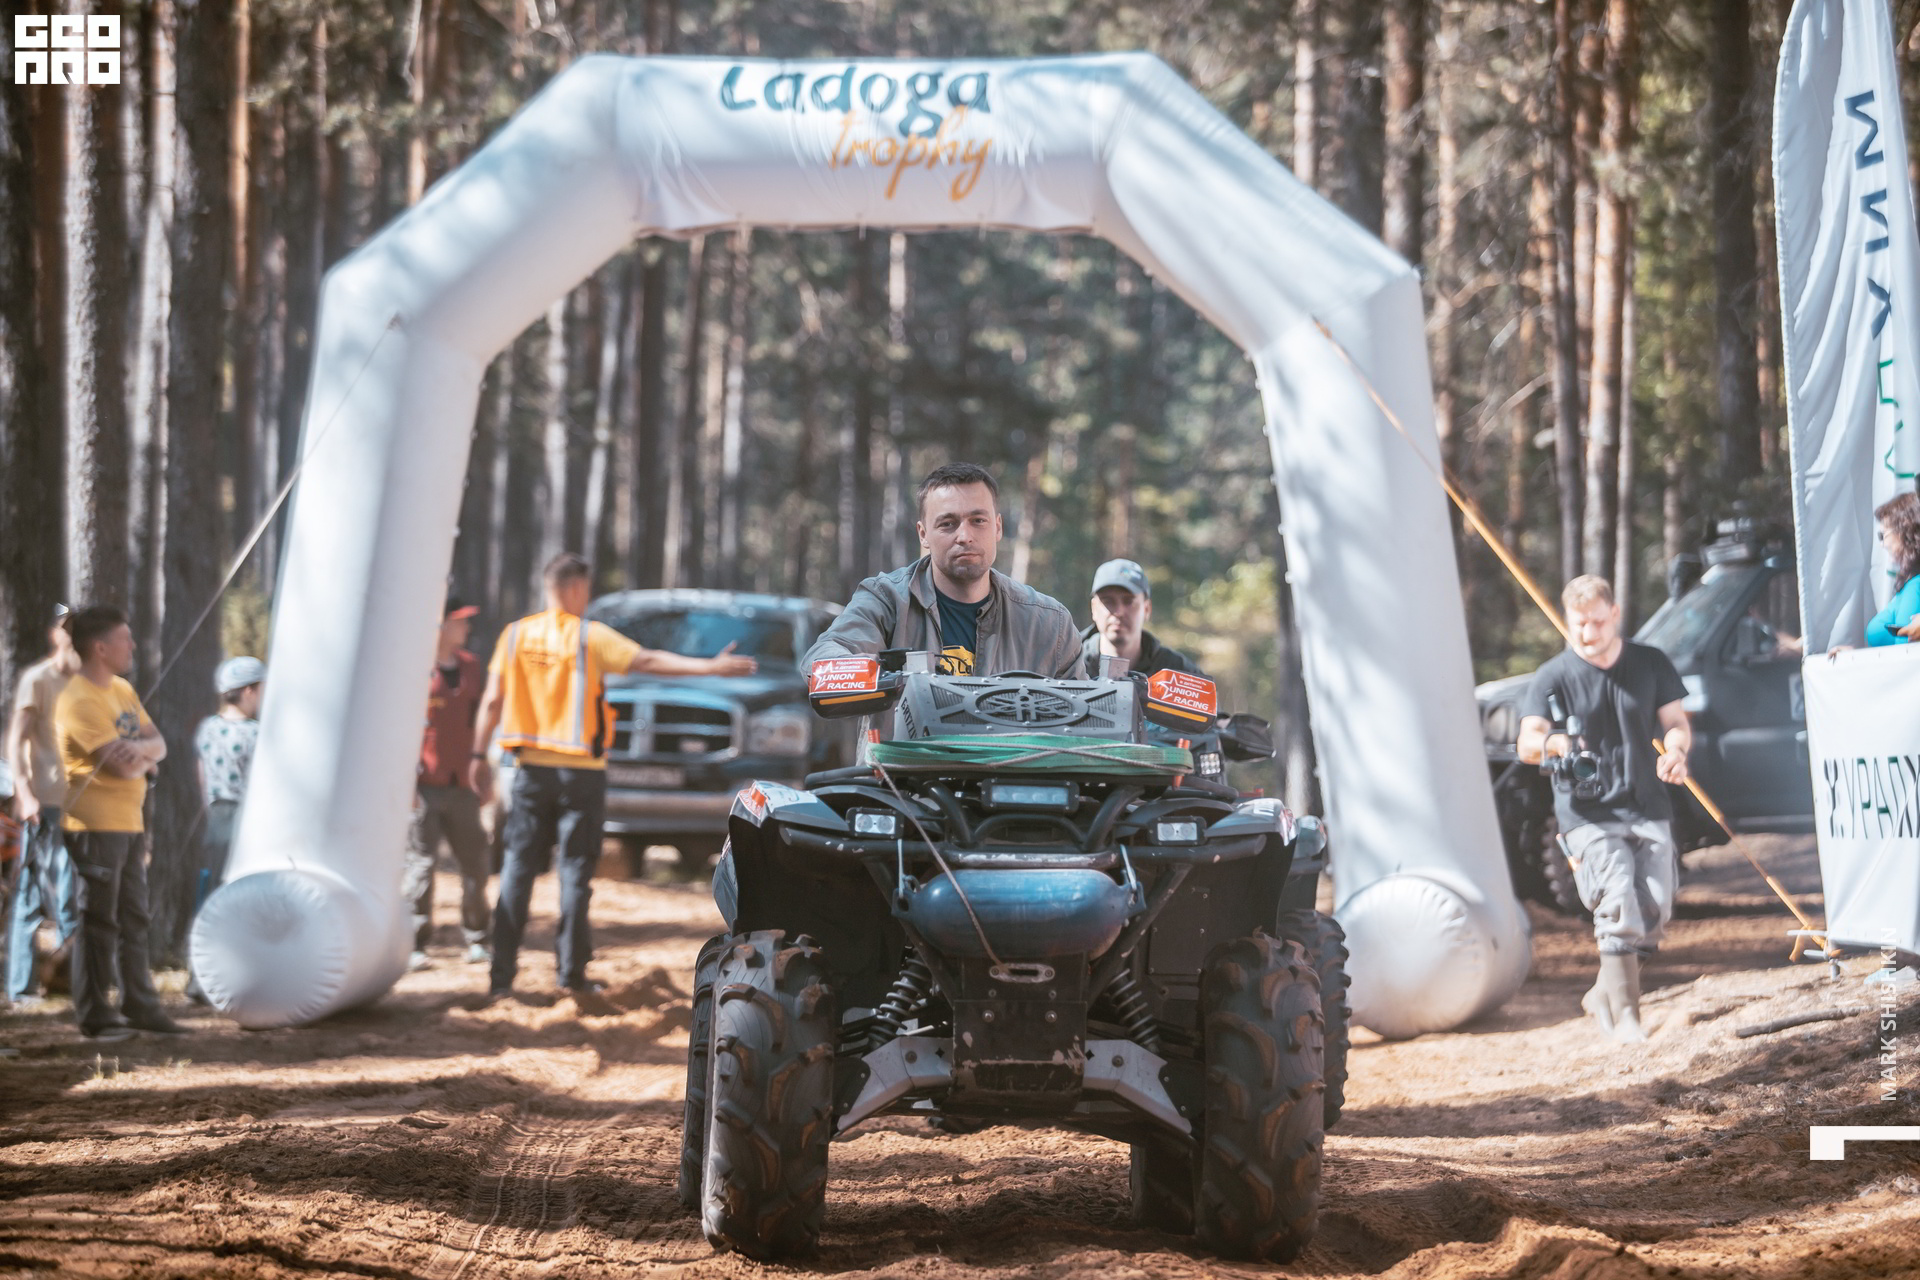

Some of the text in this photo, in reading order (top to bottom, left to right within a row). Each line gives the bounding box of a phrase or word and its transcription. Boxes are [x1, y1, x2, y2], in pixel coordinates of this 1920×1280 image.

[721, 65, 991, 138] Ladoga
[827, 104, 993, 201] trophy
[823, 673, 856, 681] UNION
[827, 681, 867, 690] RACING
[1169, 686, 1200, 699] UNION
[1173, 696, 1209, 711] RACING
